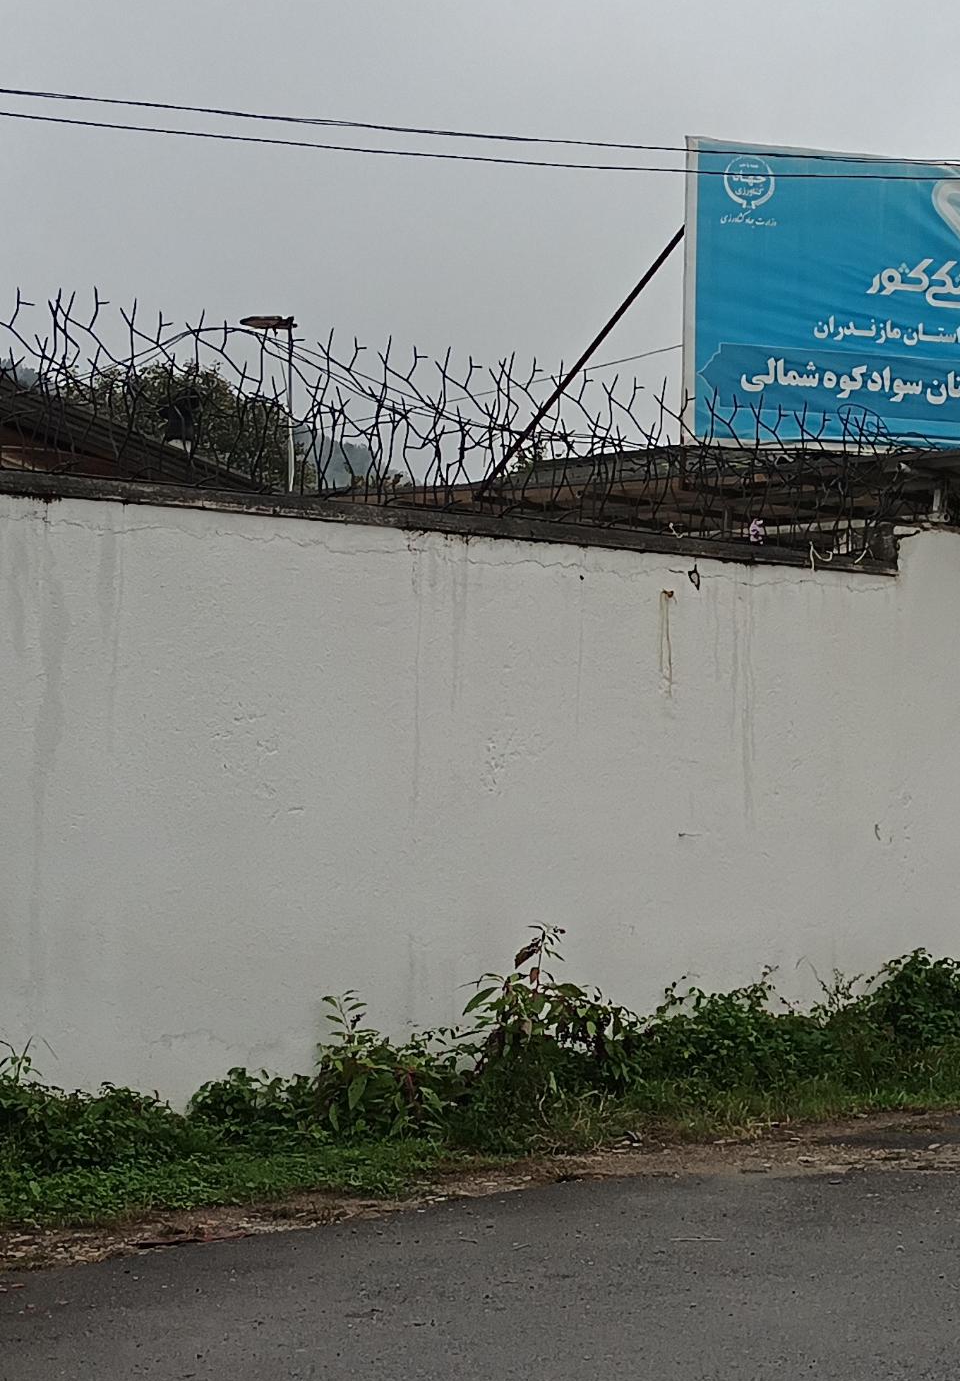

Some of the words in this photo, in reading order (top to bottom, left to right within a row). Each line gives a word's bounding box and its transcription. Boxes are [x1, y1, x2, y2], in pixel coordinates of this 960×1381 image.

[866, 258, 934, 296] کشور
[813, 315, 901, 344] مازندران
[740, 357, 820, 392] شمالی
